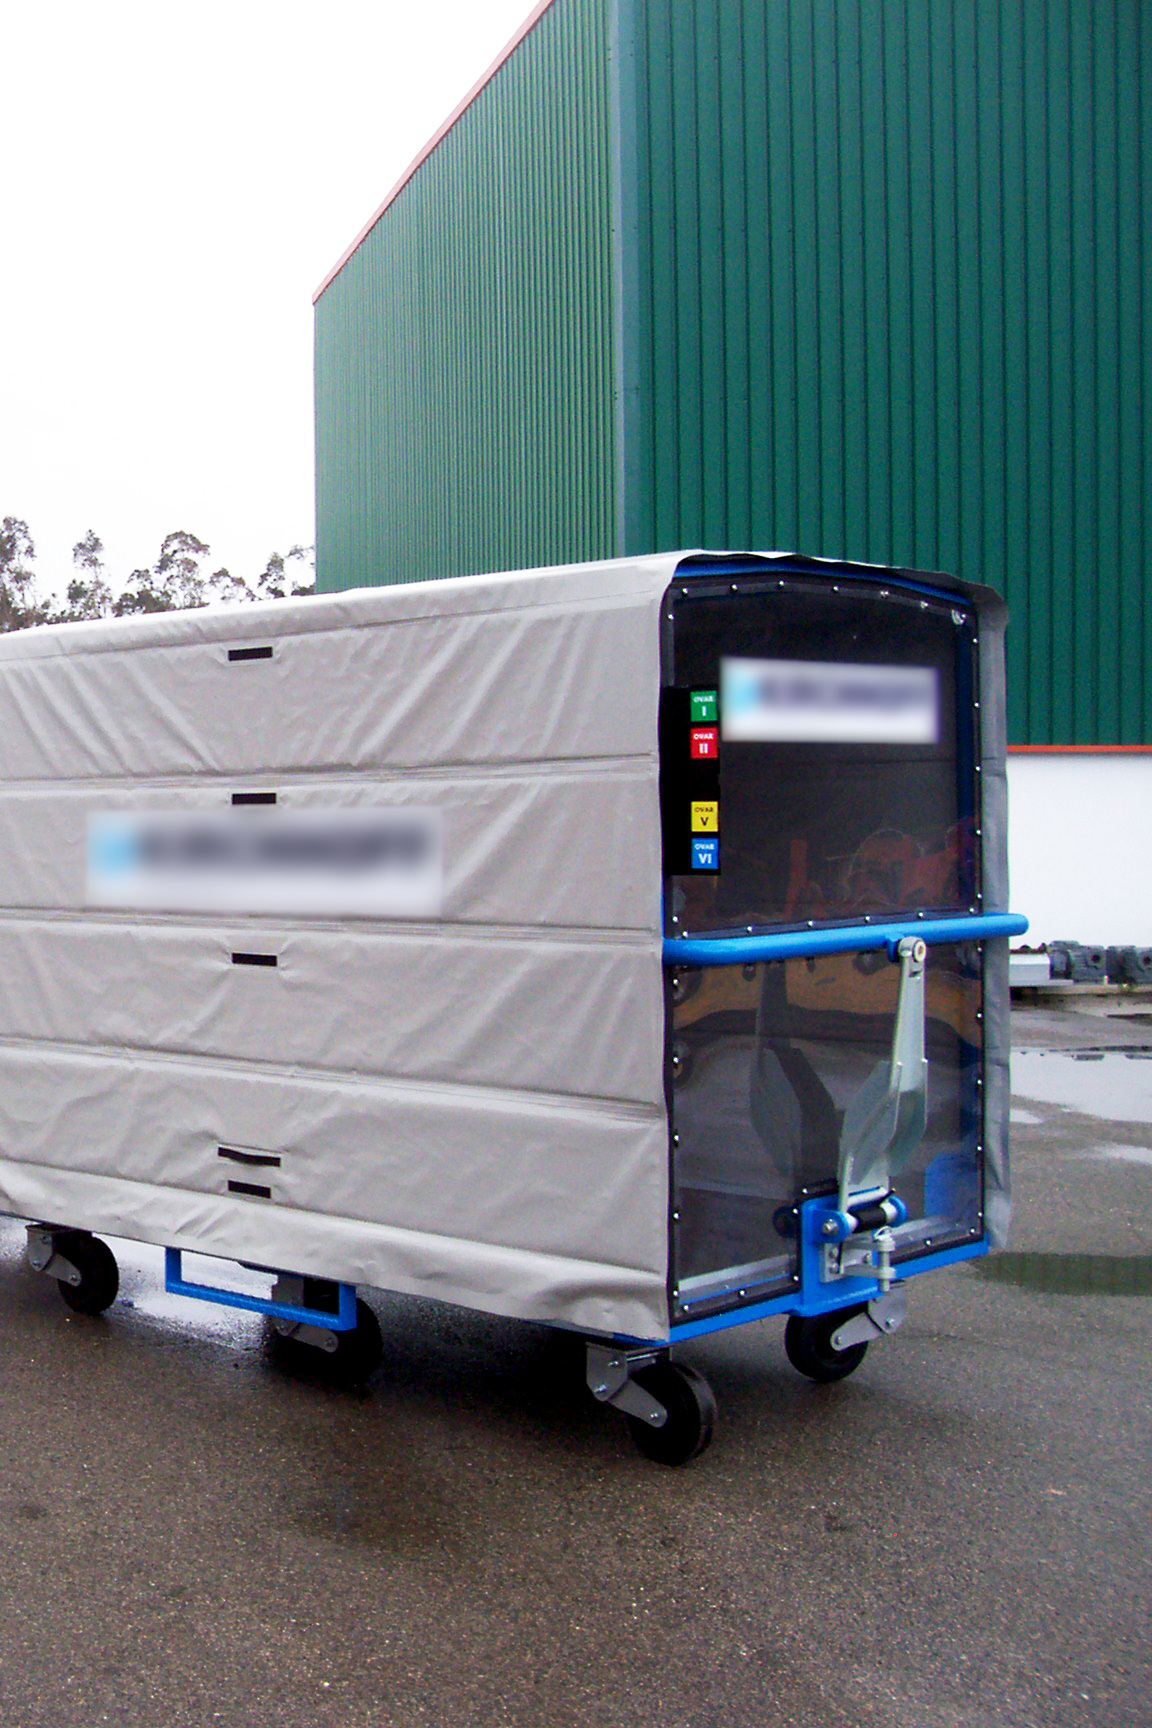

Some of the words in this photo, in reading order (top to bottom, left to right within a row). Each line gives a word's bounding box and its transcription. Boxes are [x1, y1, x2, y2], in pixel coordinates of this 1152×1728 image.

[693, 695, 714, 703] OVAR
[699, 743, 708, 754] II
[700, 816, 708, 826] V
[698, 853, 712, 864] VI
